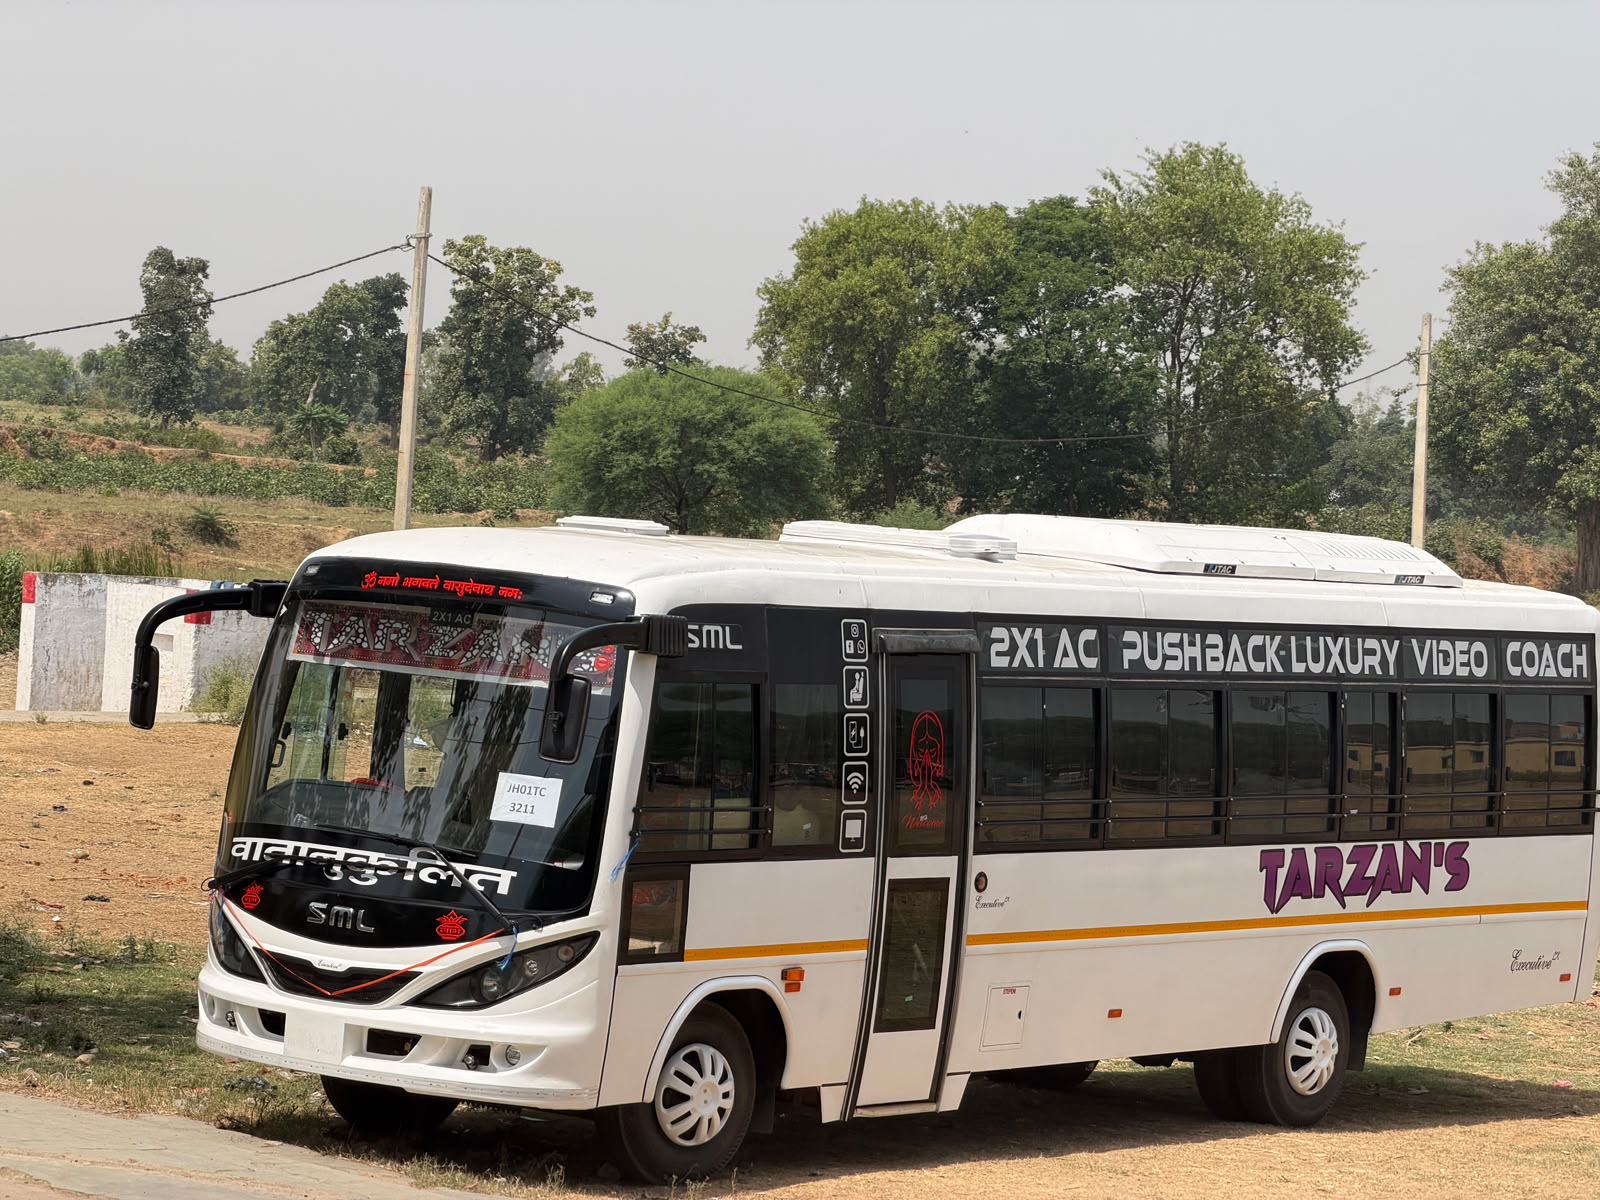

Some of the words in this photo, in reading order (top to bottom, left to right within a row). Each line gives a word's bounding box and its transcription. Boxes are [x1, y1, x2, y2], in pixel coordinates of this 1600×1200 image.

[1211, 564, 1233, 574] JTAC
[378, 572, 400, 587] नमो
[403, 574, 440, 590] भगवते
[443, 578, 496, 597] वासुदेवाय
[498, 586, 523, 600] नमः
[432, 610, 453, 623] 2X1
[455, 612, 472, 625] AC
[687, 624, 743, 650] SML
[990, 626, 1045, 668] 2X1
[1053, 627, 1099, 668] AC
[1122, 630, 1284, 673] PUSHBACK
[1290, 635, 1400, 676] LUXURY
[1411, 638, 1489, 678] VIDEO
[1506, 641, 1588, 678] COACH
[506, 783, 547, 797] JH01TC
[509, 802, 535, 815] 3211
[1259, 840, 1471, 914] TARZAN'S
[975, 895, 1005, 909] Executive
[306, 901, 375, 933] SML
[1510, 948, 1552, 973] Executive
